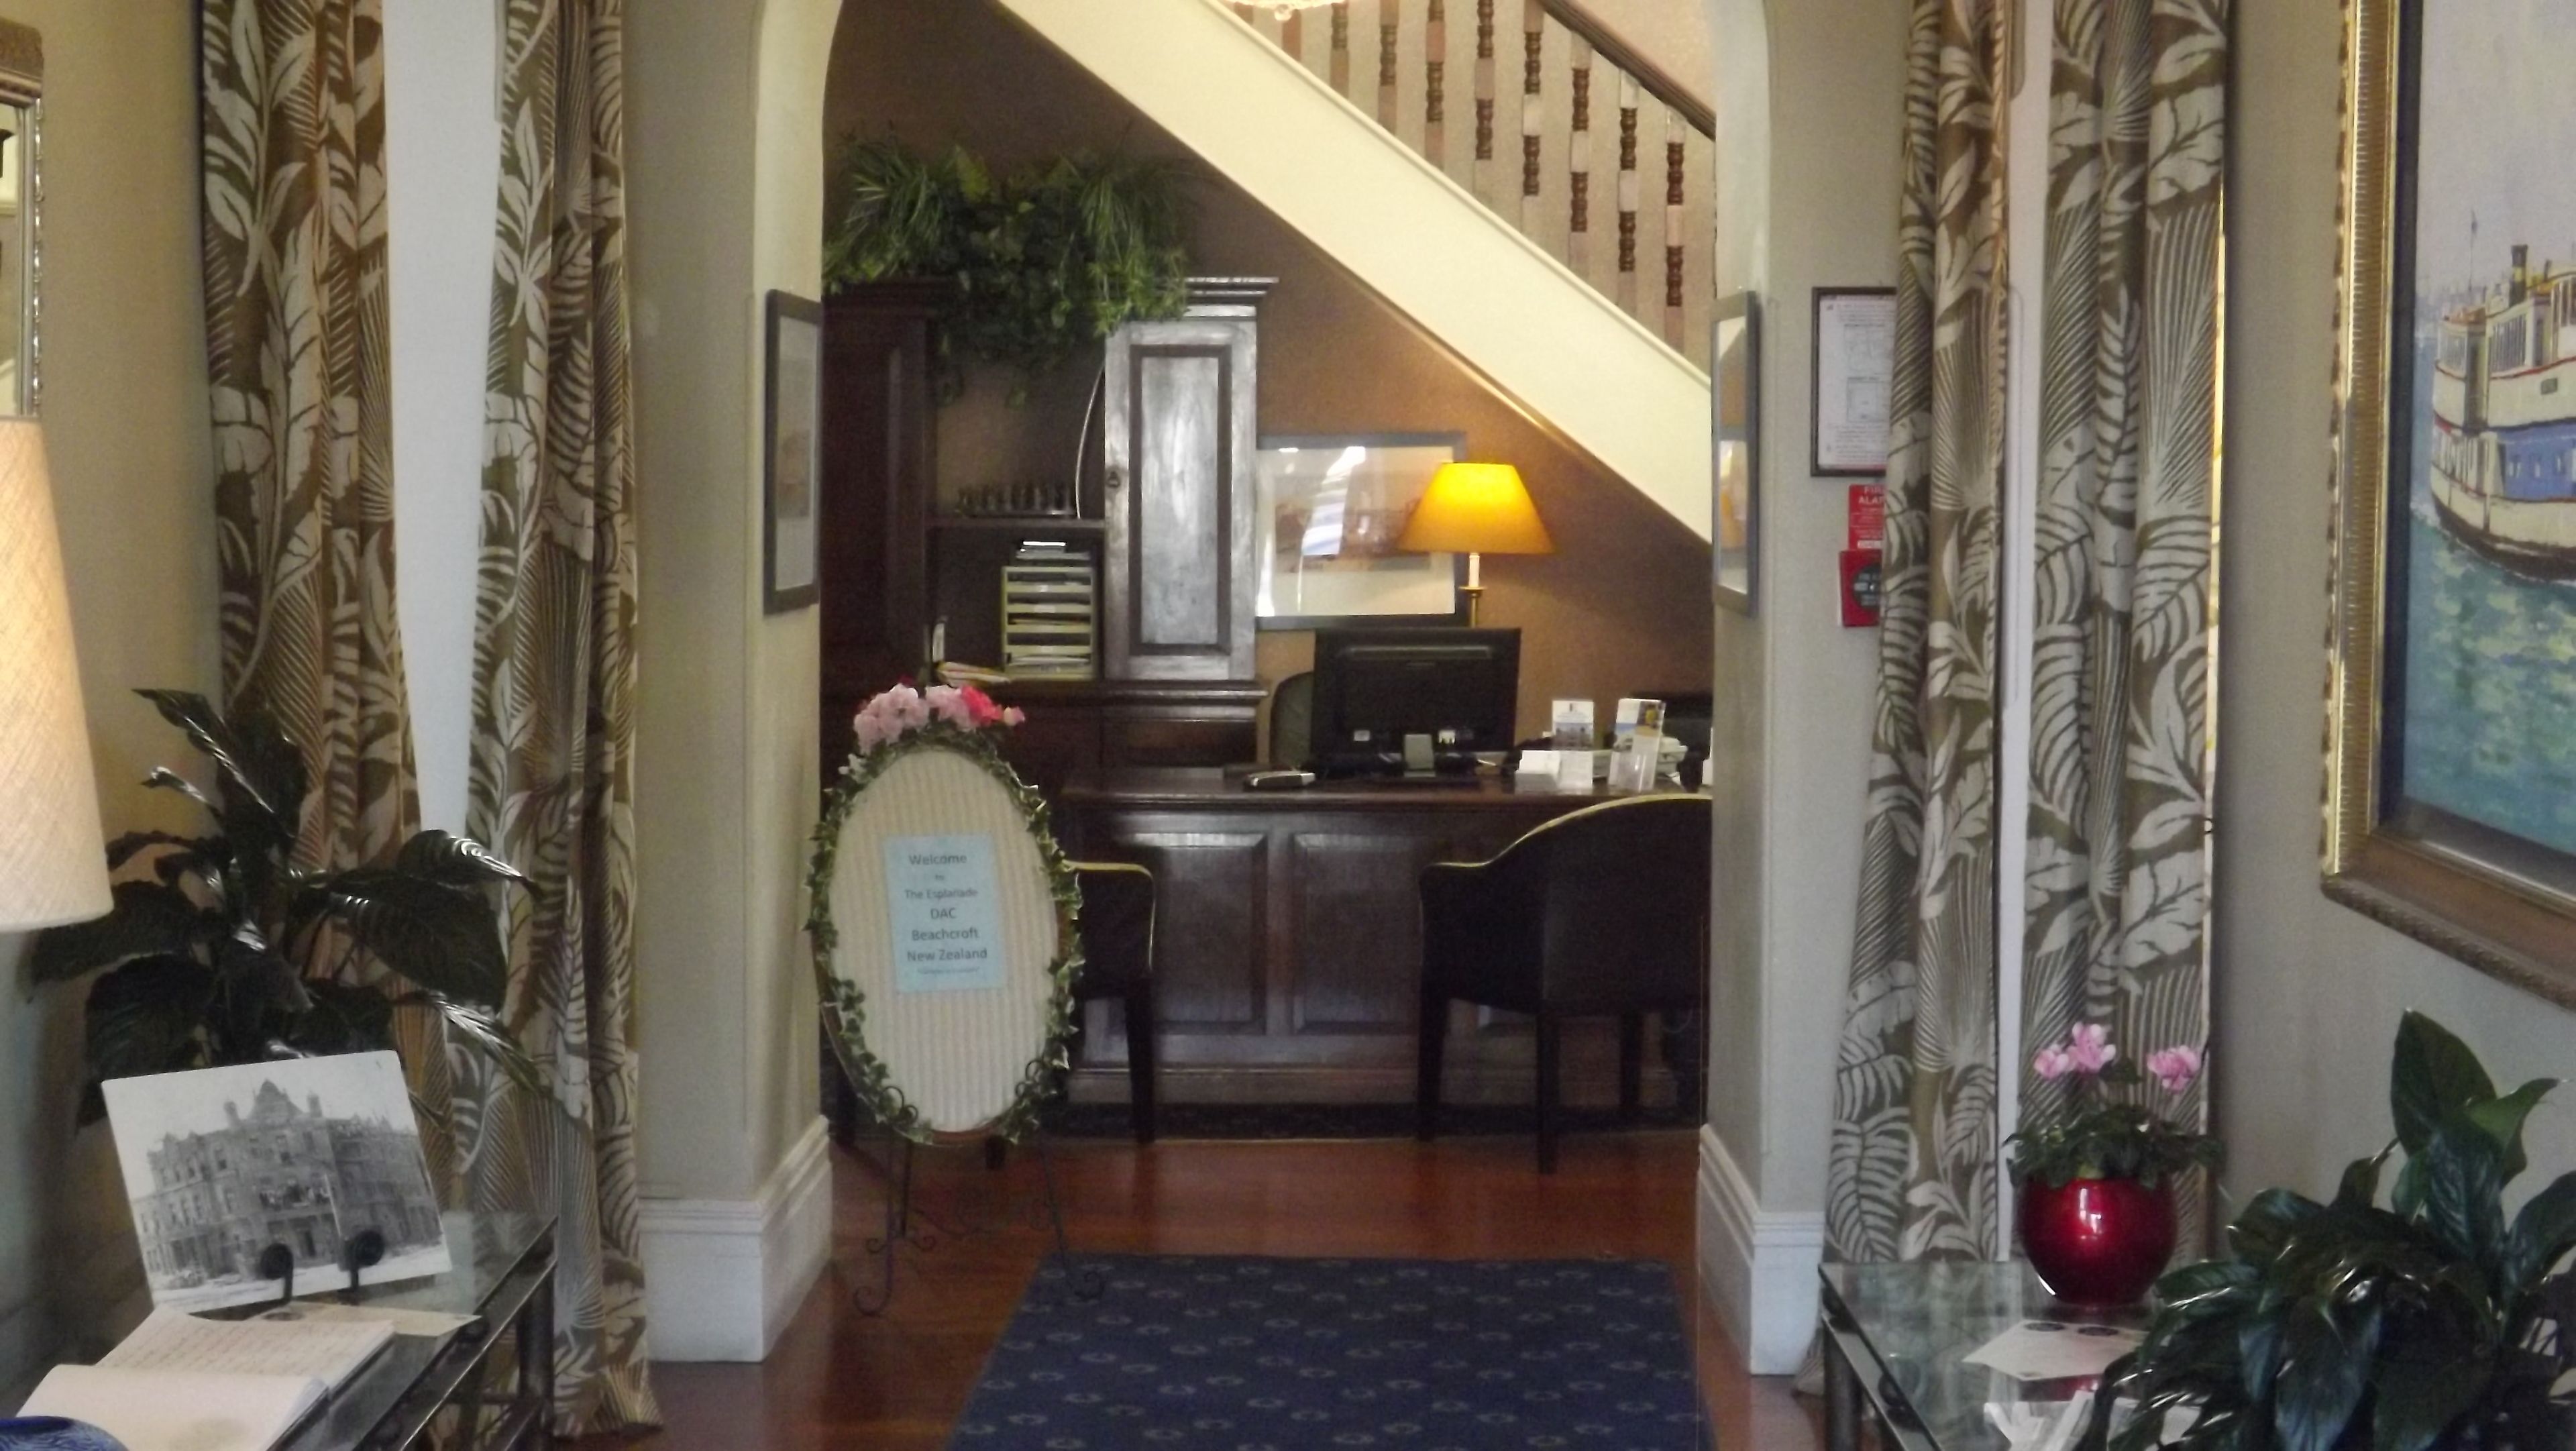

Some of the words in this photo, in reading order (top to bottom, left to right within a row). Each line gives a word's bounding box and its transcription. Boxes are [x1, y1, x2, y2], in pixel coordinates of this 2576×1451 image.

[908, 854, 967, 865] Welcome
[904, 890, 923, 899] The
[926, 888, 978, 900] Esplanade
[930, 908, 957, 920] DAC
[912, 927, 979, 941] Beachcroft
[907, 951, 935, 962] New
[938, 947, 987, 961] Zealand
